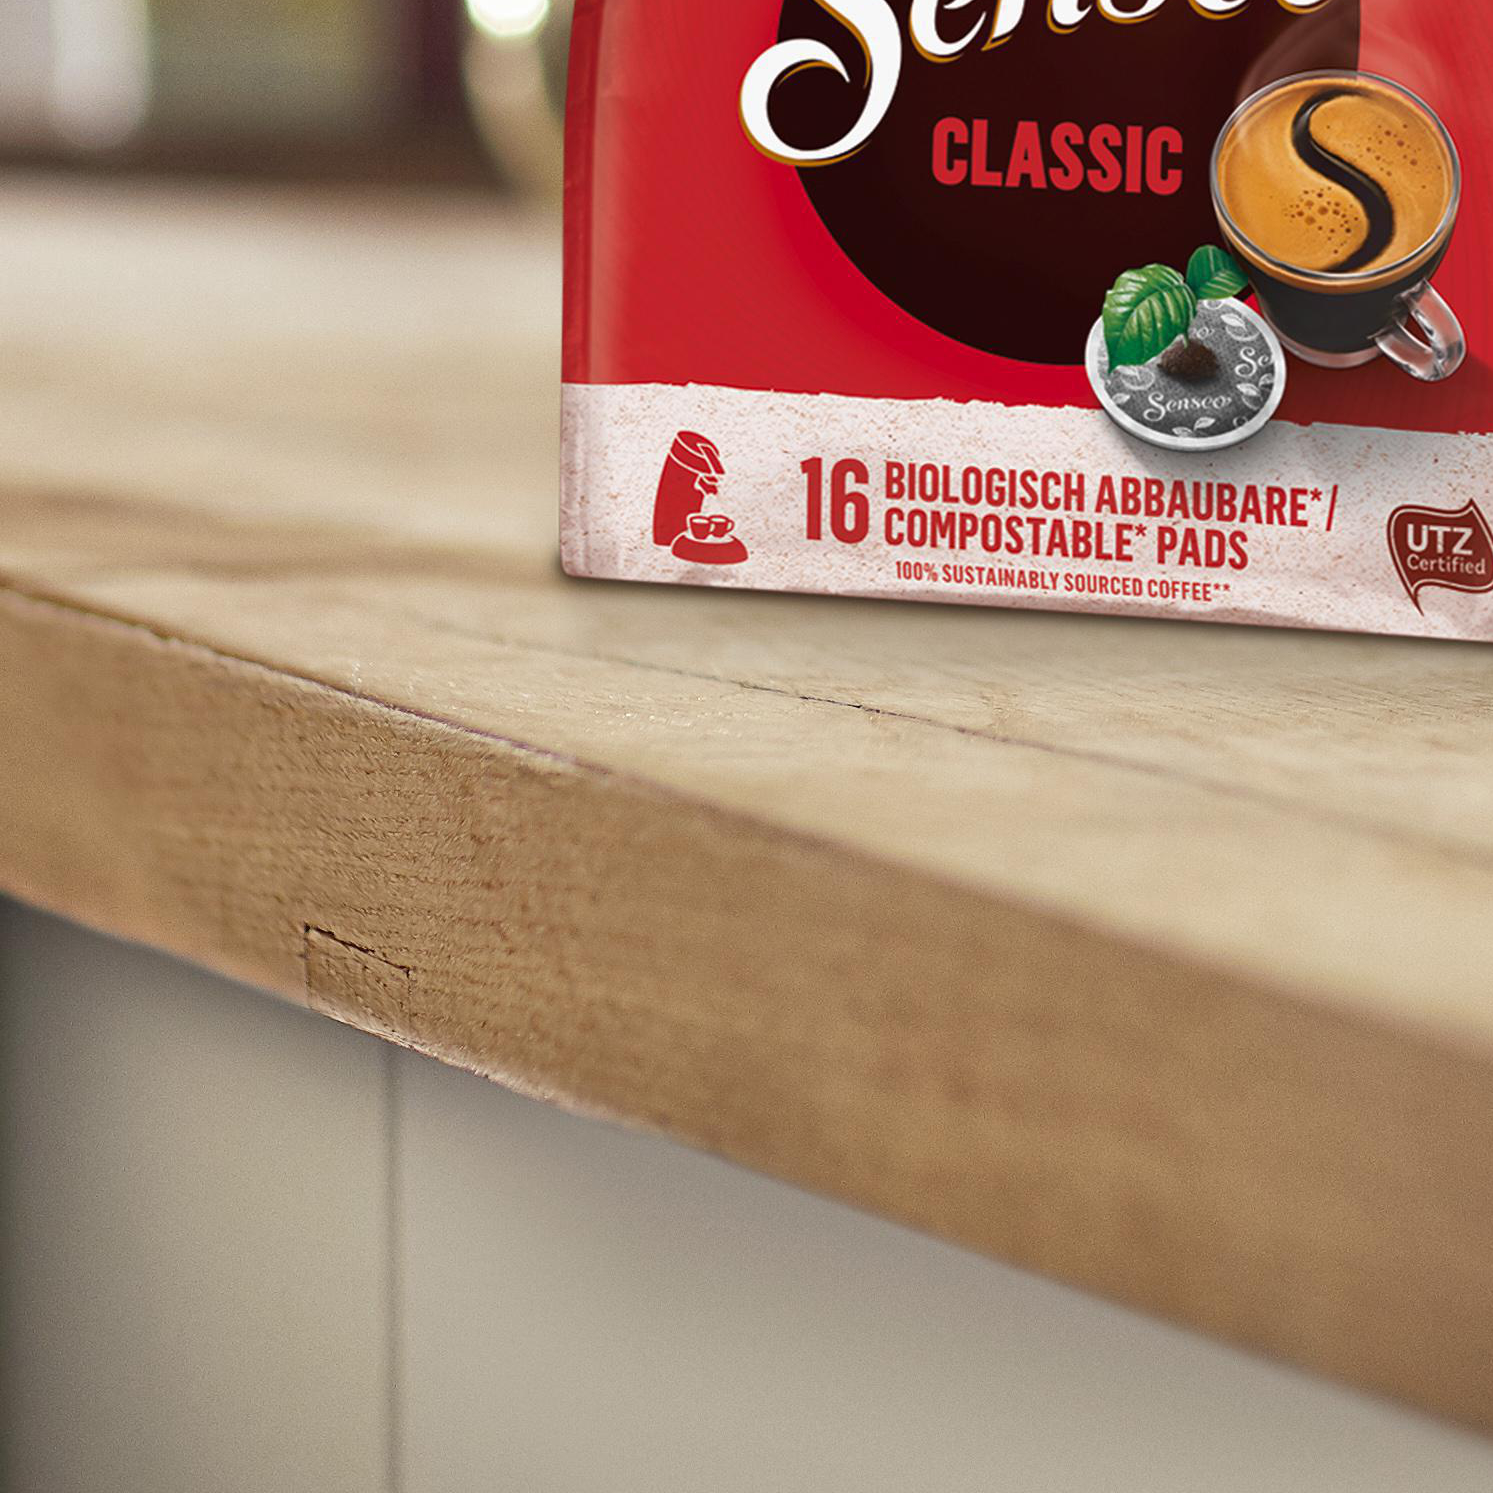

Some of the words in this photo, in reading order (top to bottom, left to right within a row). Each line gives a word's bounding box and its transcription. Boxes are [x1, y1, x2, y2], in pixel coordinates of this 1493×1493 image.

[931, 116, 1184, 195] CLASSIC
[1143, 390, 1232, 422] Senseo
[800, 456, 870, 545] 16
[884, 460, 1086, 513] BIOLOGISCH
[1157, 525, 1249, 571] PADS
[1406, 523, 1473, 556] UTZ
[895, 560, 938, 583] 100%
[942, 564, 1059, 591] SUSTAINABLY
[1064, 572, 1143, 597] SOURCED
[1406, 553, 1486, 575] Certified
